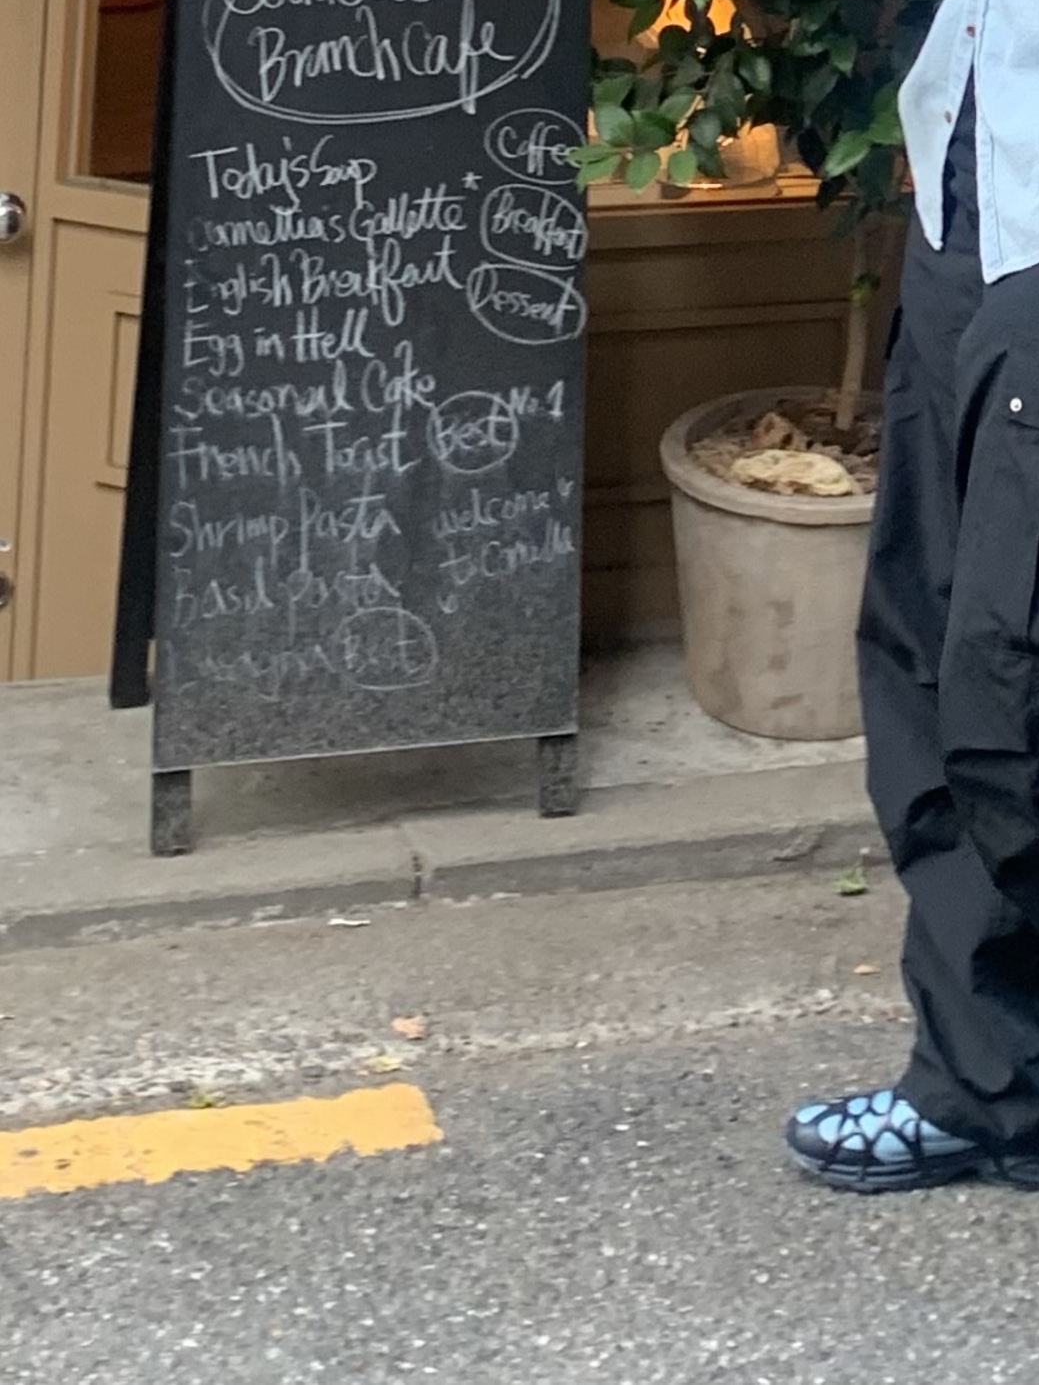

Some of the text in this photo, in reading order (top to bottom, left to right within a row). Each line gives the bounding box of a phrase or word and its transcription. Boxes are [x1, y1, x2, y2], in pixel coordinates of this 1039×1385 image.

[183, 306, 376, 377] Egg in Hell
